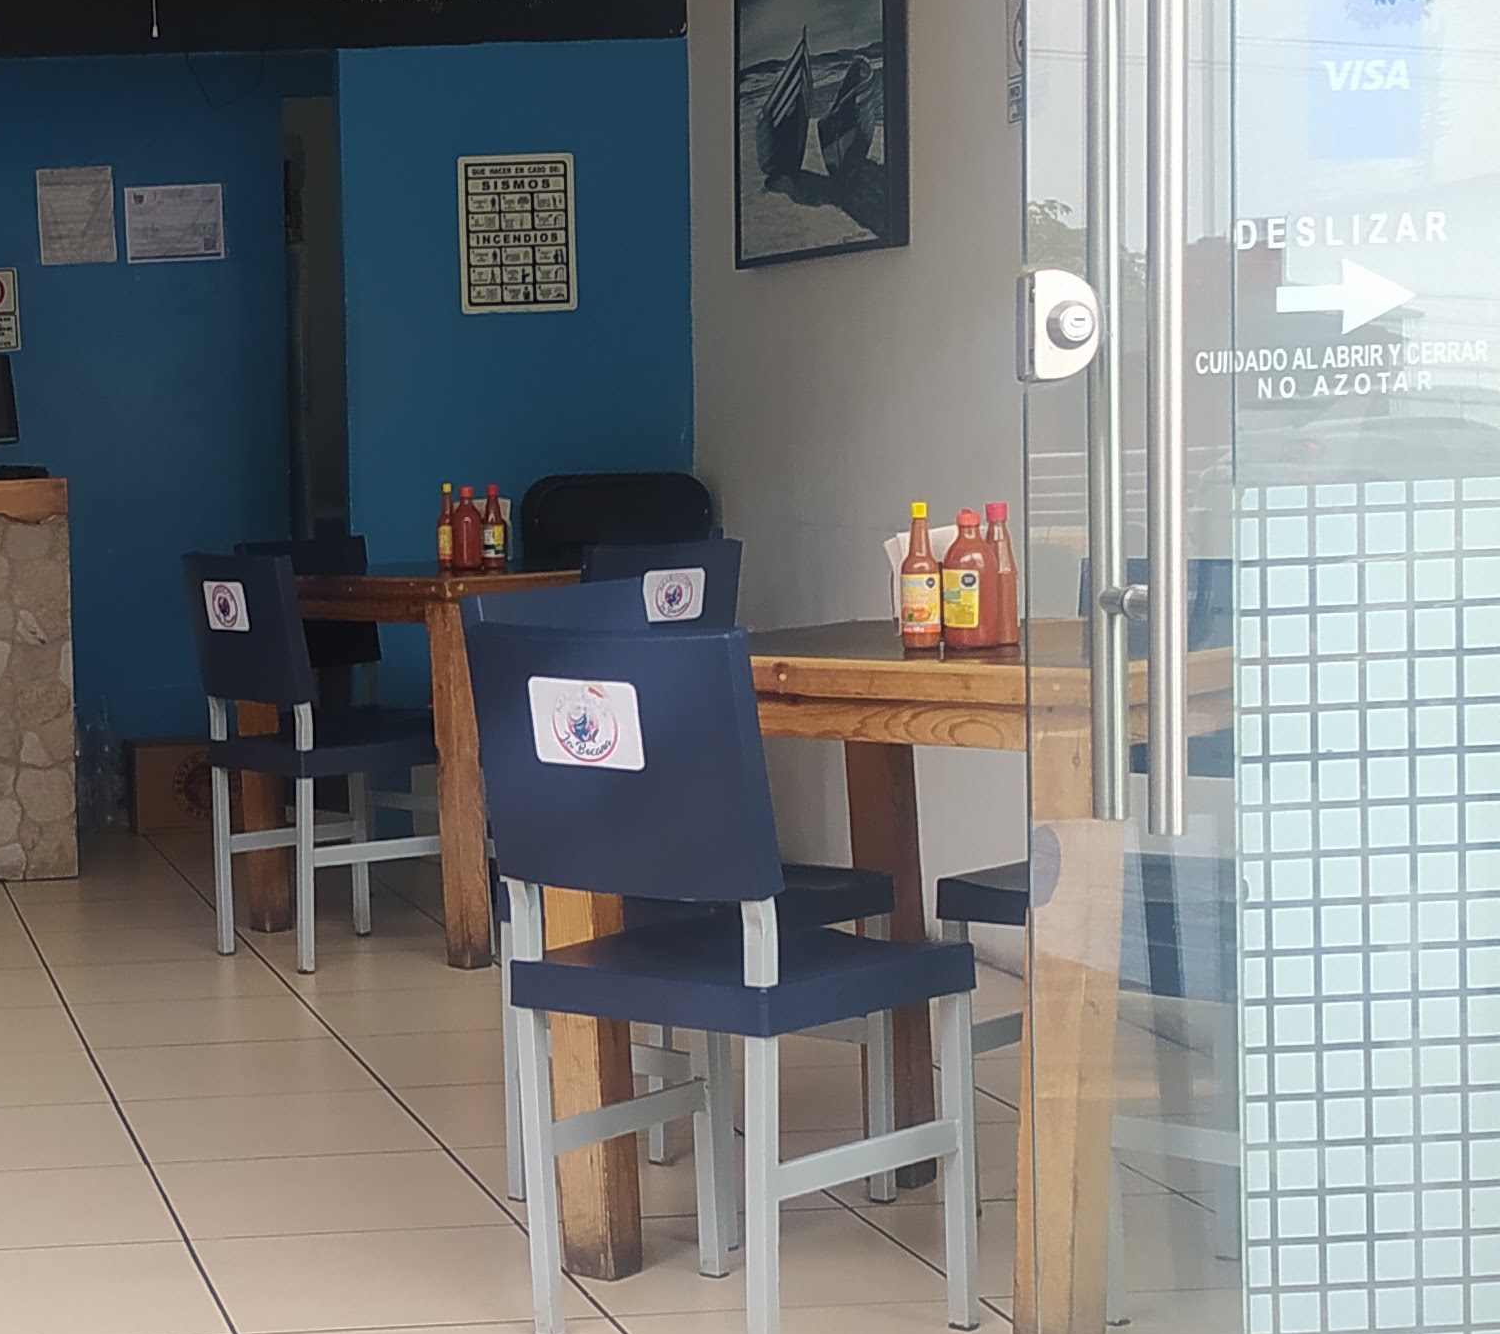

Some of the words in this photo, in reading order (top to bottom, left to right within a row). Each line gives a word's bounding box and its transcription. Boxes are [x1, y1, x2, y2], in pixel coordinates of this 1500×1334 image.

[1318, 58, 1411, 92] VISA
[481, 178, 551, 191] SISMOS
[475, 232, 559, 245] INCENDIOS
[1236, 210, 1449, 251] DESLIZAR
[1291, 346, 1320, 372] AL
[1321, 344, 1385, 369] ABRIR
[1386, 343, 1403, 367] Y
[1405, 339, 1489, 367] CERRAR
[1256, 375, 1297, 400] NO
[1312, 370, 1433, 395] AZOTAR
